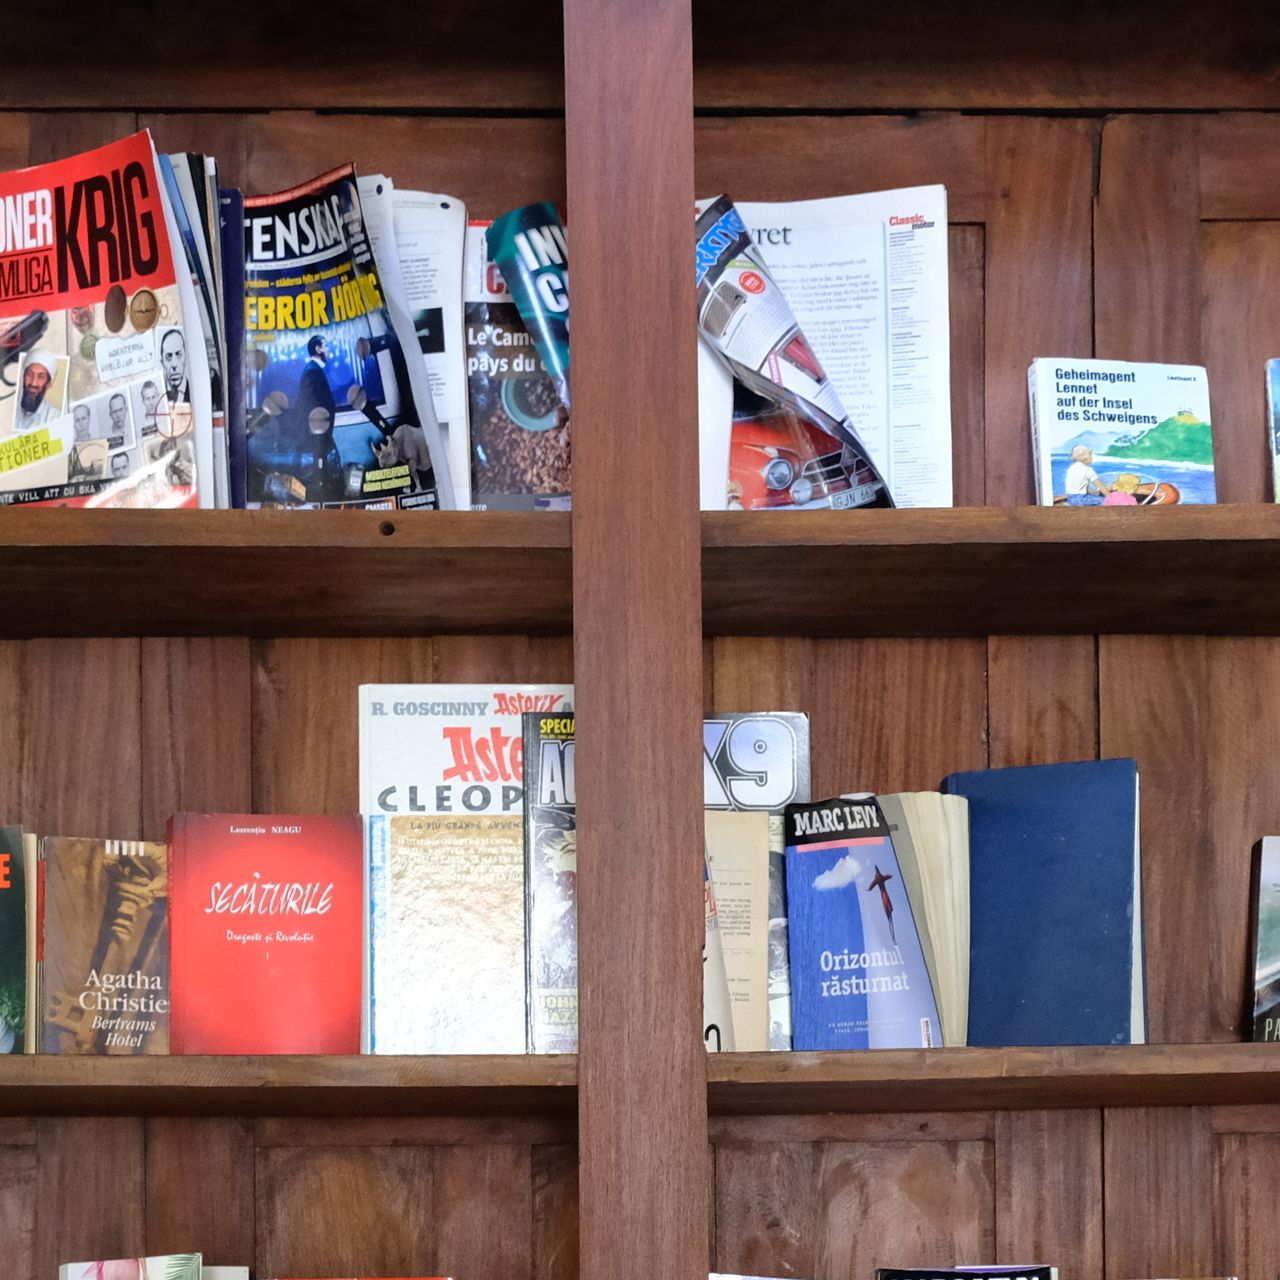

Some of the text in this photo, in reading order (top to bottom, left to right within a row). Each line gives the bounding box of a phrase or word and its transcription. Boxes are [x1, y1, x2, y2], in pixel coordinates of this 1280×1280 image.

[54, 160, 159, 294] KRIG
[888, 213, 925, 227] Classic
[911, 220, 935, 231] motor
[467, 327, 488, 347] Le
[467, 354, 536, 378] pays du
[1055, 367, 1136, 384] Geheimagent
[1056, 381, 1098, 395] Lennet
[1056, 395, 1133, 410] auf der Insel
[1057, 409, 1158, 425] des Schweigens
[371, 691, 565, 717] R. GOSCINNY Asterix
[271, 825, 302, 835] NEAGU
[793, 804, 880, 837] MARC LEVY
[820, 944, 905, 972] Orizontul
[84, 968, 163, 991] Agatha
[821, 971, 911, 997] răsturnat
[78, 992, 170, 1013] Christie
[91, 1014, 157, 1032] Bertrams
[104, 1030, 143, 1048] Hotel
